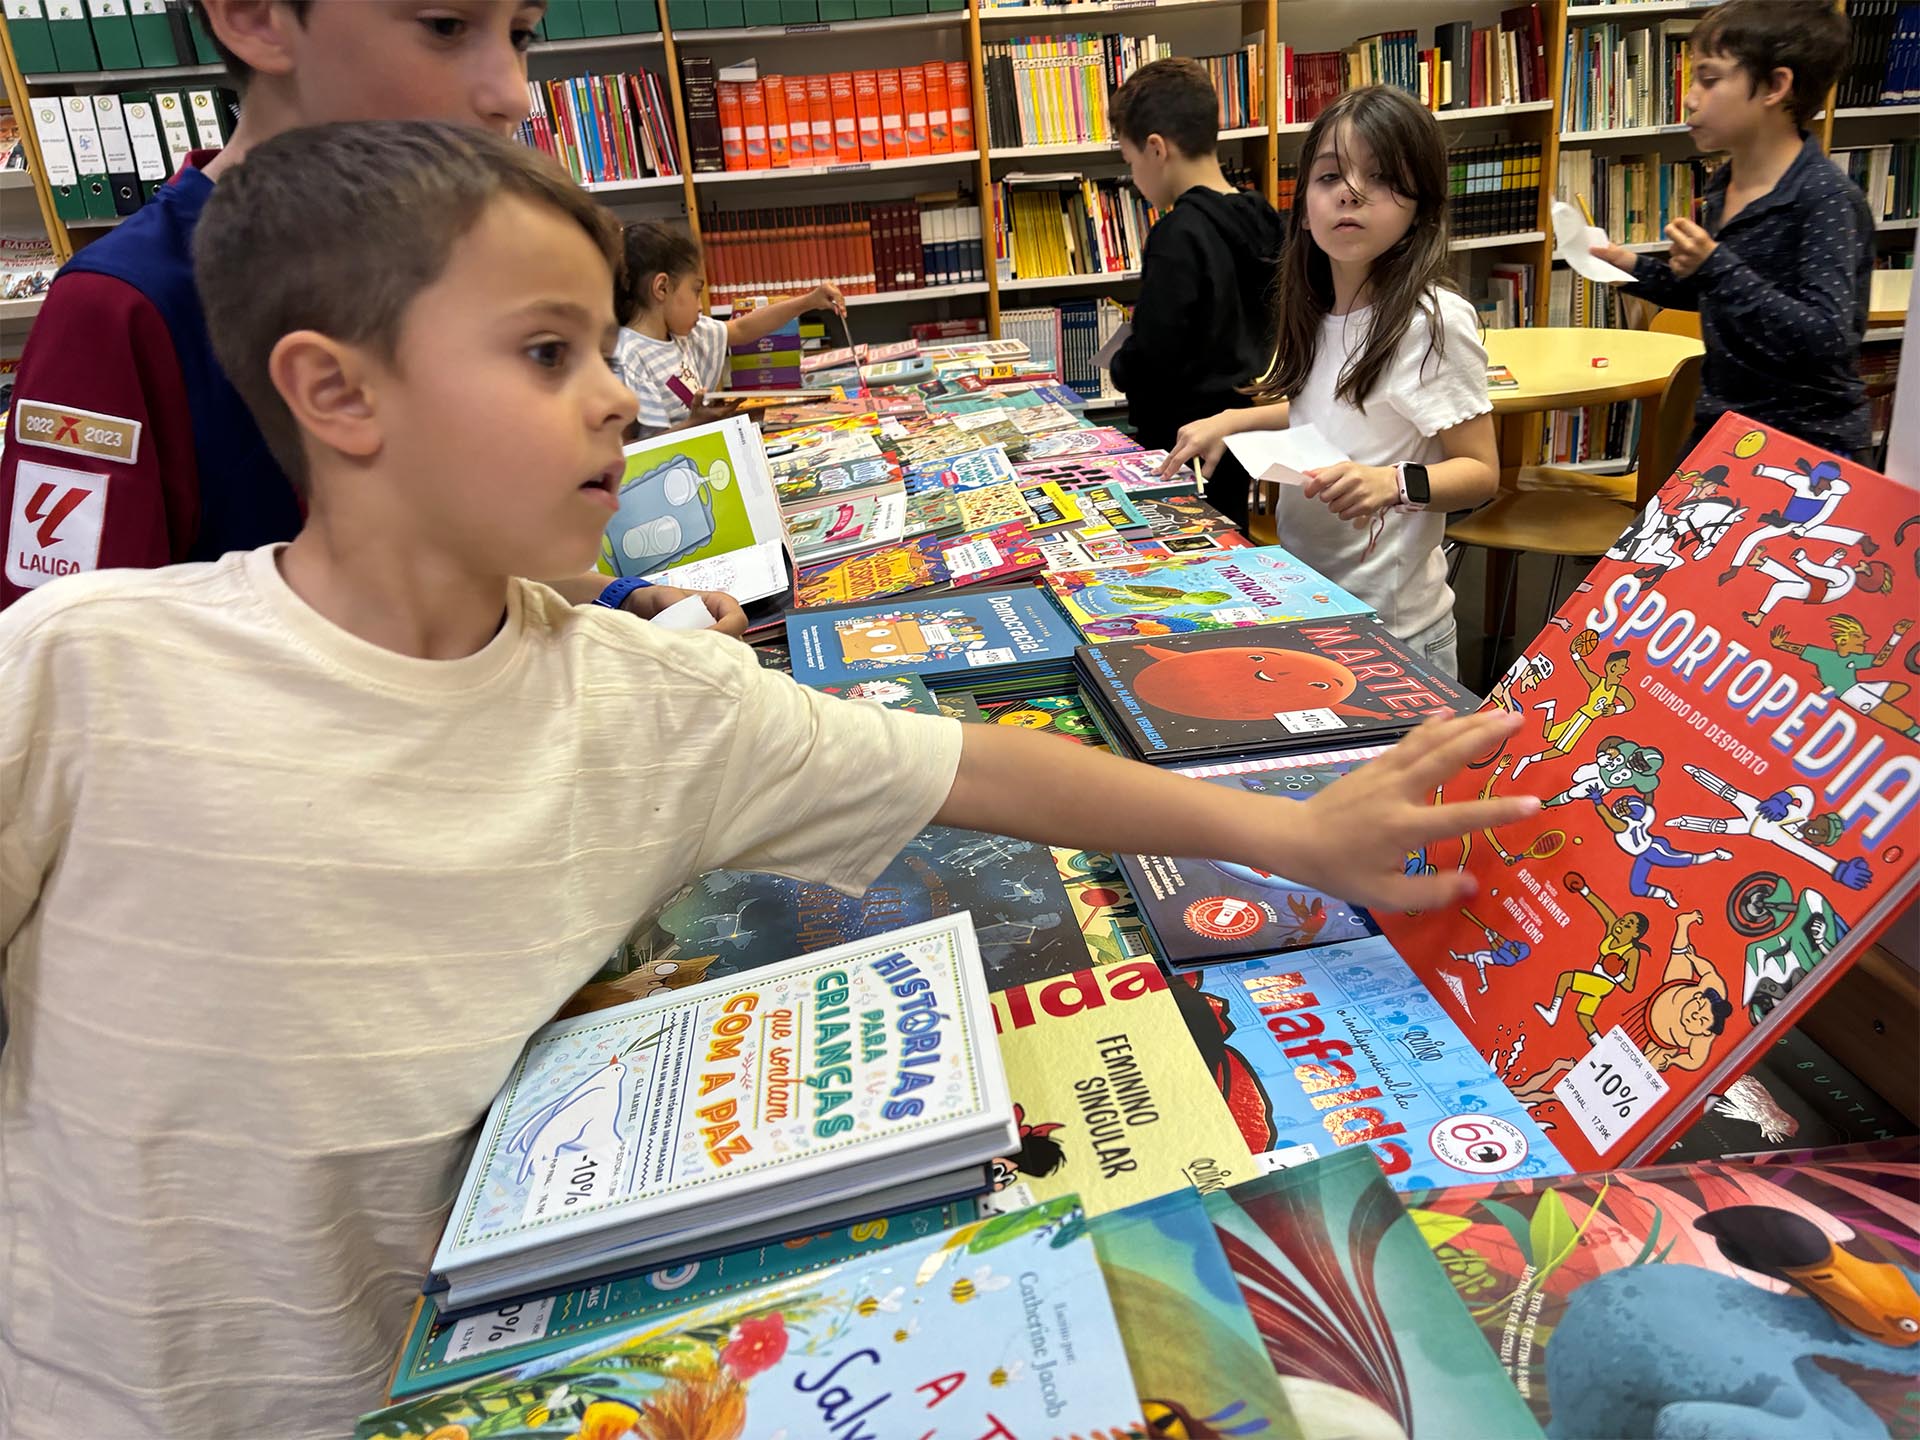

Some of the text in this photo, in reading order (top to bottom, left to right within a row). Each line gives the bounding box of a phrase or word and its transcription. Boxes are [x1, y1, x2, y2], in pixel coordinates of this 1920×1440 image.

[26, 415, 123, 447] 2022 2023
[19, 551, 80, 576] LALIGA
[847, 559, 877, 597] DESPORTO
[1213, 564, 1282, 609] TARTARUGA
[987, 595, 1050, 655] Democracia!
[1298, 626, 1457, 719] MARTE!
[1135, 716, 1168, 751] VERMELHO
[1586, 572, 1920, 855] SPORTOPÉDIA
[1650, 682, 1690, 722] MUNDO
[1689, 711, 1714, 737] DO
[1703, 722, 1770, 777] DESPORTO
[1502, 896, 1545, 945] MARK LONG
[1517, 868, 1571, 928] ADAM SKINNER
[677, 1010, 691, 1047] BIOGRAFIAS
[859, 1008, 888, 1063] PARA
[868, 951, 953, 1121] HISTÓRIAS
[660, 1053, 669, 1073] PARA
[669, 1054, 682, 1086] MOMENTOS
[763, 1008, 806, 1124] que sonham
[804, 970, 856, 1139] CRIANÇAS
[1242, 971, 1413, 1177] Mafalda
[1341, 1012, 1402, 1095] indispensável
[1392, 1080, 1410, 1110] da
[1619, 1041, 1643, 1069] EDITORA
[652, 1087, 665, 1113] MUNDO
[697, 992, 761, 1168] COM A PAZ
[1096, 1033, 1160, 1127] FEMININO
[1589, 1061, 1638, 1118] -10%
[627, 1095, 642, 1122] MARVEL
[648, 1111, 661, 1144] MELHOR
[661, 1086, 676, 1135] HISTÓRICOS
[1074, 1077, 1138, 1180] SINGULAR
[655, 1133, 669, 1183] INSPIRADORES
[1450, 1122, 1508, 1163] 60
[563, 1154, 598, 1206] -10%
[486, 1303, 523, 1342] 0%
[1528, 1292, 1546, 1316] TEXTO
[1018, 1270, 1069, 1420] Catherine Jacob
[1518, 1327, 1535, 1366] CRISTINA
[916, 1371, 967, 1408] A
